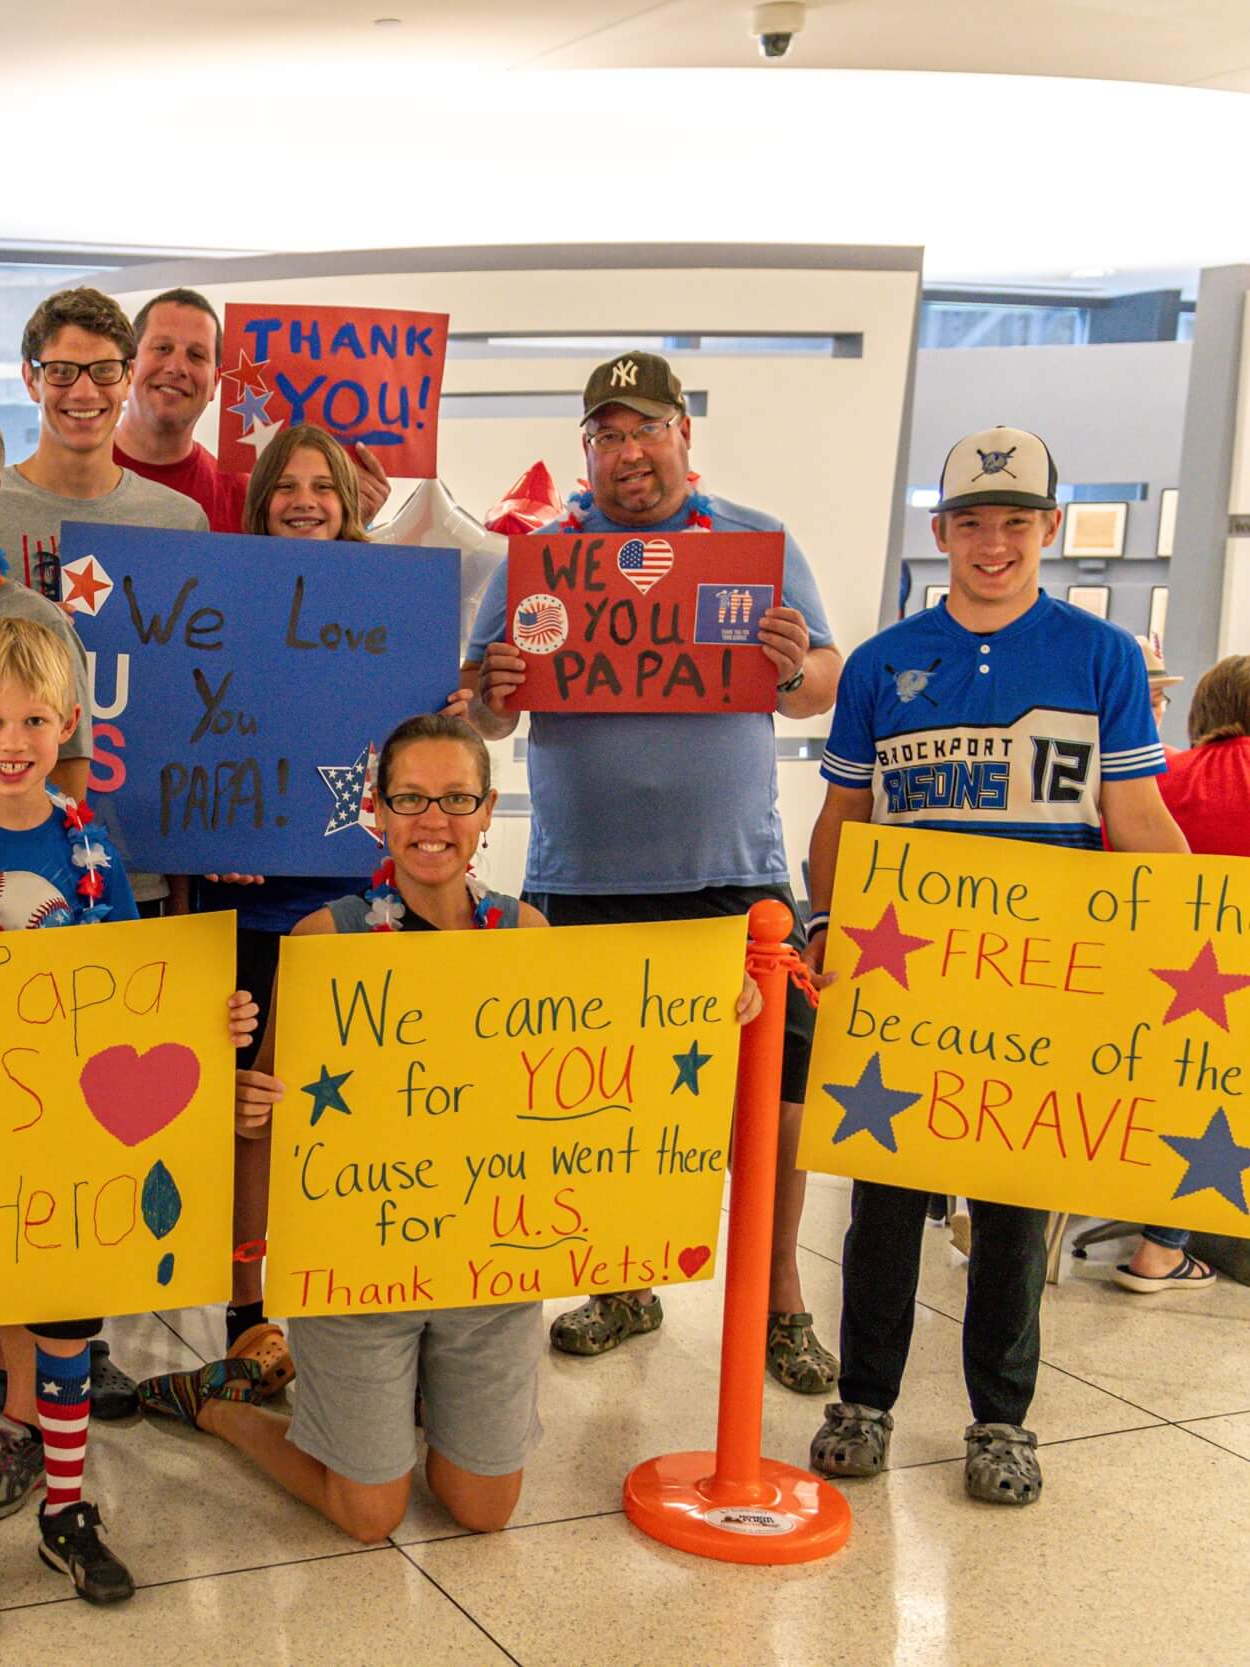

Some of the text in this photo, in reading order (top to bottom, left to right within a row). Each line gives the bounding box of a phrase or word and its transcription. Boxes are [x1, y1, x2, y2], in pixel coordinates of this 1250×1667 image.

[243, 318, 433, 362] THANK
[610, 359, 639, 388] NY
[274, 373, 431, 430] YOU!
[542, 539, 607, 592] WE
[122, 575, 225, 649] We
[286, 575, 388, 655] Love
[583, 598, 685, 645] YOU
[190, 668, 257, 744] You
[877, 738, 1013, 766] BROCKPORT
[1030, 735, 1095, 803] 12
[159, 757, 289, 837] PAPA!
[863, 839, 1249, 935] Home of th
[942, 928, 1106, 995] FREE
[331, 958, 722, 1047] We came here
[846, 987, 1243, 1096] because of the
[397, 1044, 636, 1118] for YOU
[928, 1070, 1158, 1167] BRAVE
[464, 1149, 527, 1205] you
[551, 1126, 640, 1176] went
[656, 1124, 724, 1175] there
[375, 1187, 590, 1246] for U.S.
[291, 1240, 671, 1307] Thank You Vets!
